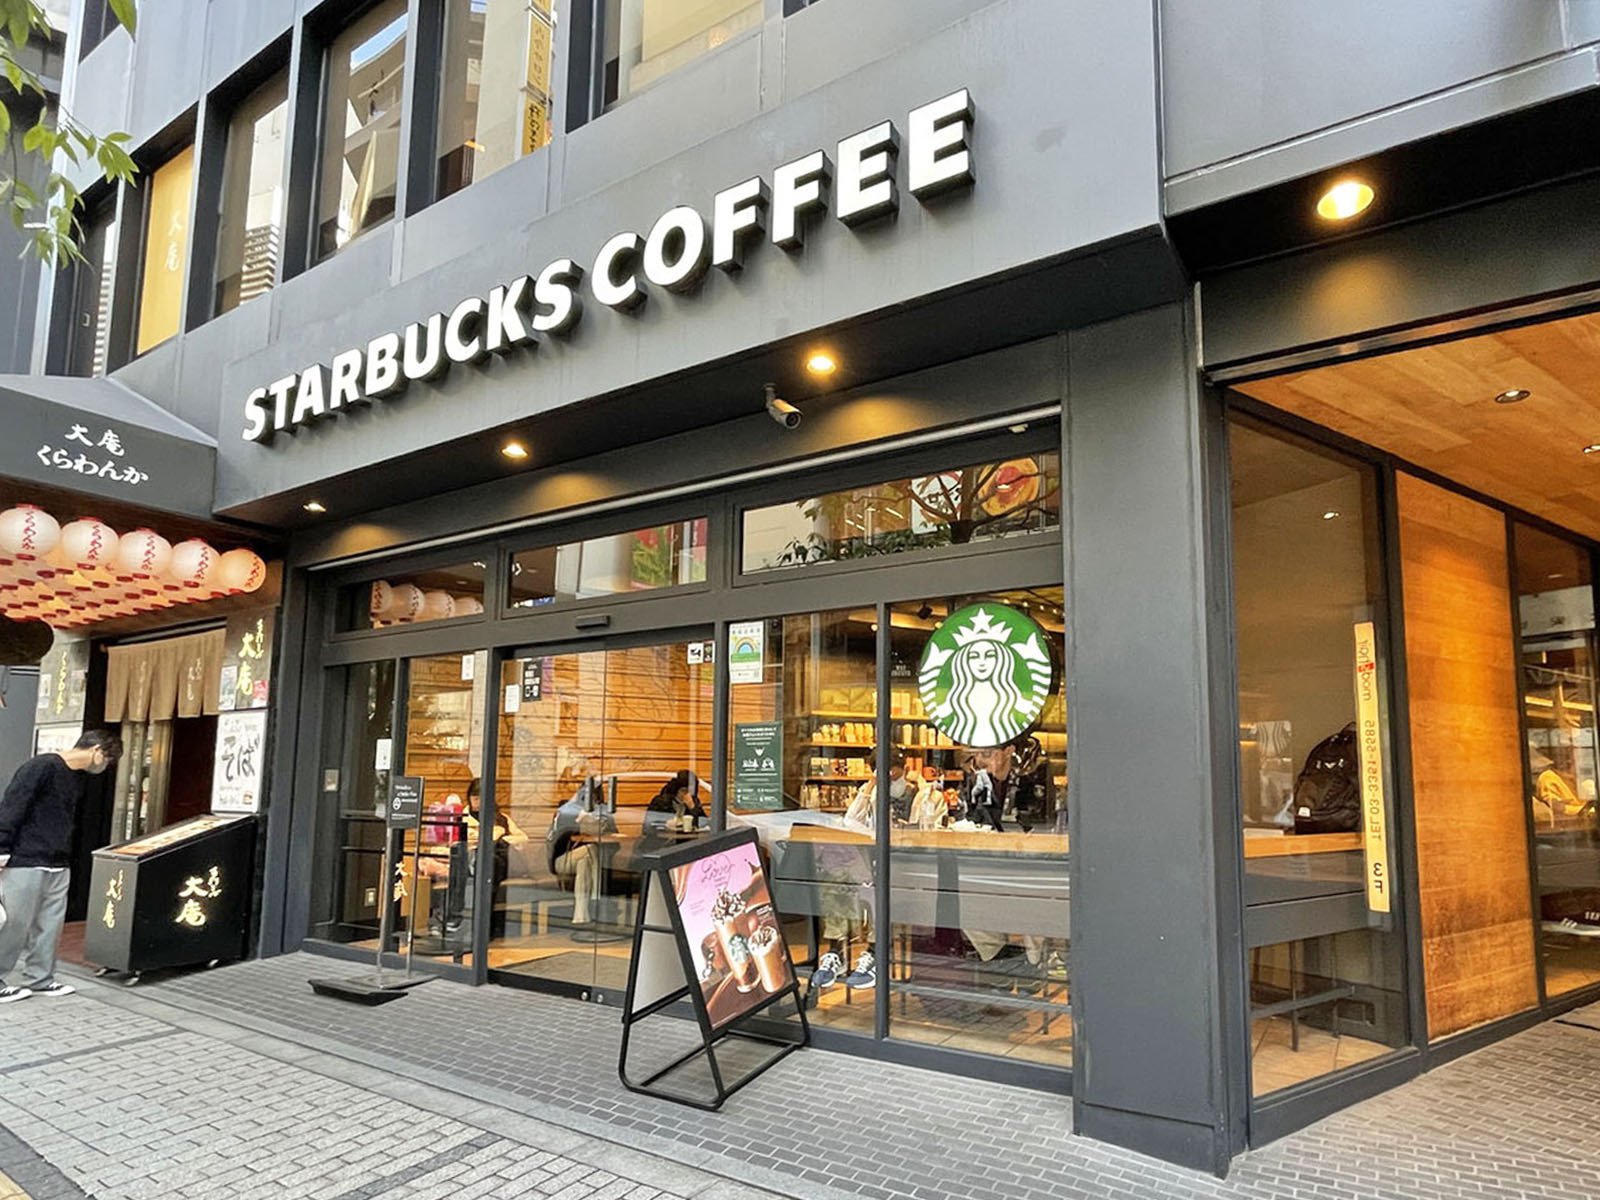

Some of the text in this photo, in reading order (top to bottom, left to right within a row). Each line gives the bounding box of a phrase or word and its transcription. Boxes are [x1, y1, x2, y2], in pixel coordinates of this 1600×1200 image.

[242, 88, 975, 442] STARBUCKS COFFEE
[65, 423, 125, 457] 大庵
[37, 445, 149, 485] くらわんか
[175, 876, 209, 927] 大庵
